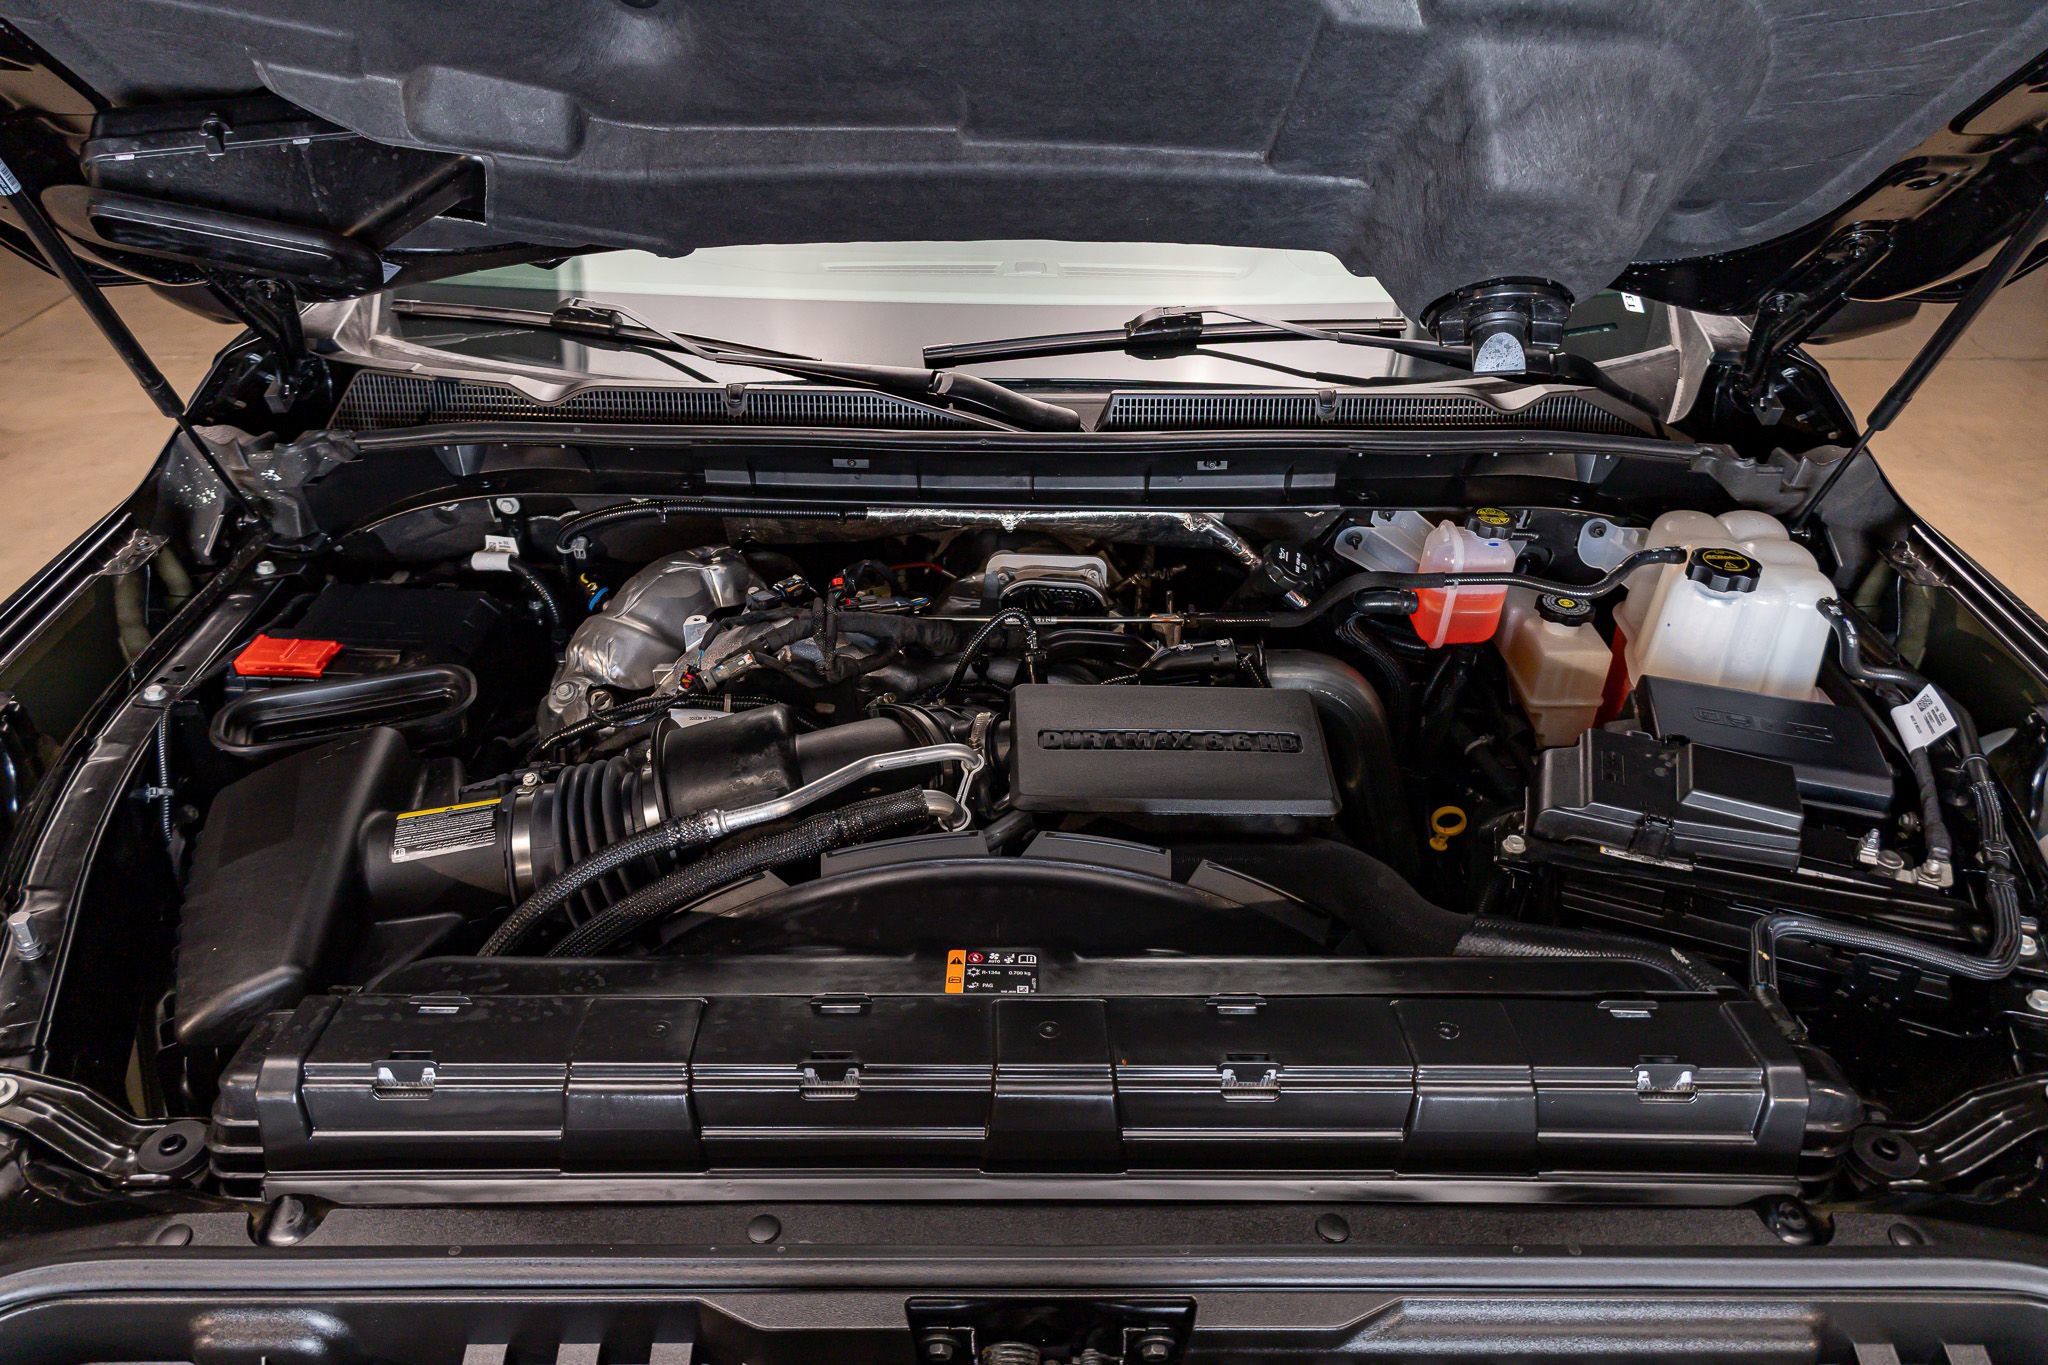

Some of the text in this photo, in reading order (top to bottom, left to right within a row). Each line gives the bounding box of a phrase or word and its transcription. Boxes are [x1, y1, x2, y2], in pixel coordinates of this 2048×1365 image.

[1043, 732, 1298, 753] DURAMAX 6.6 HD
